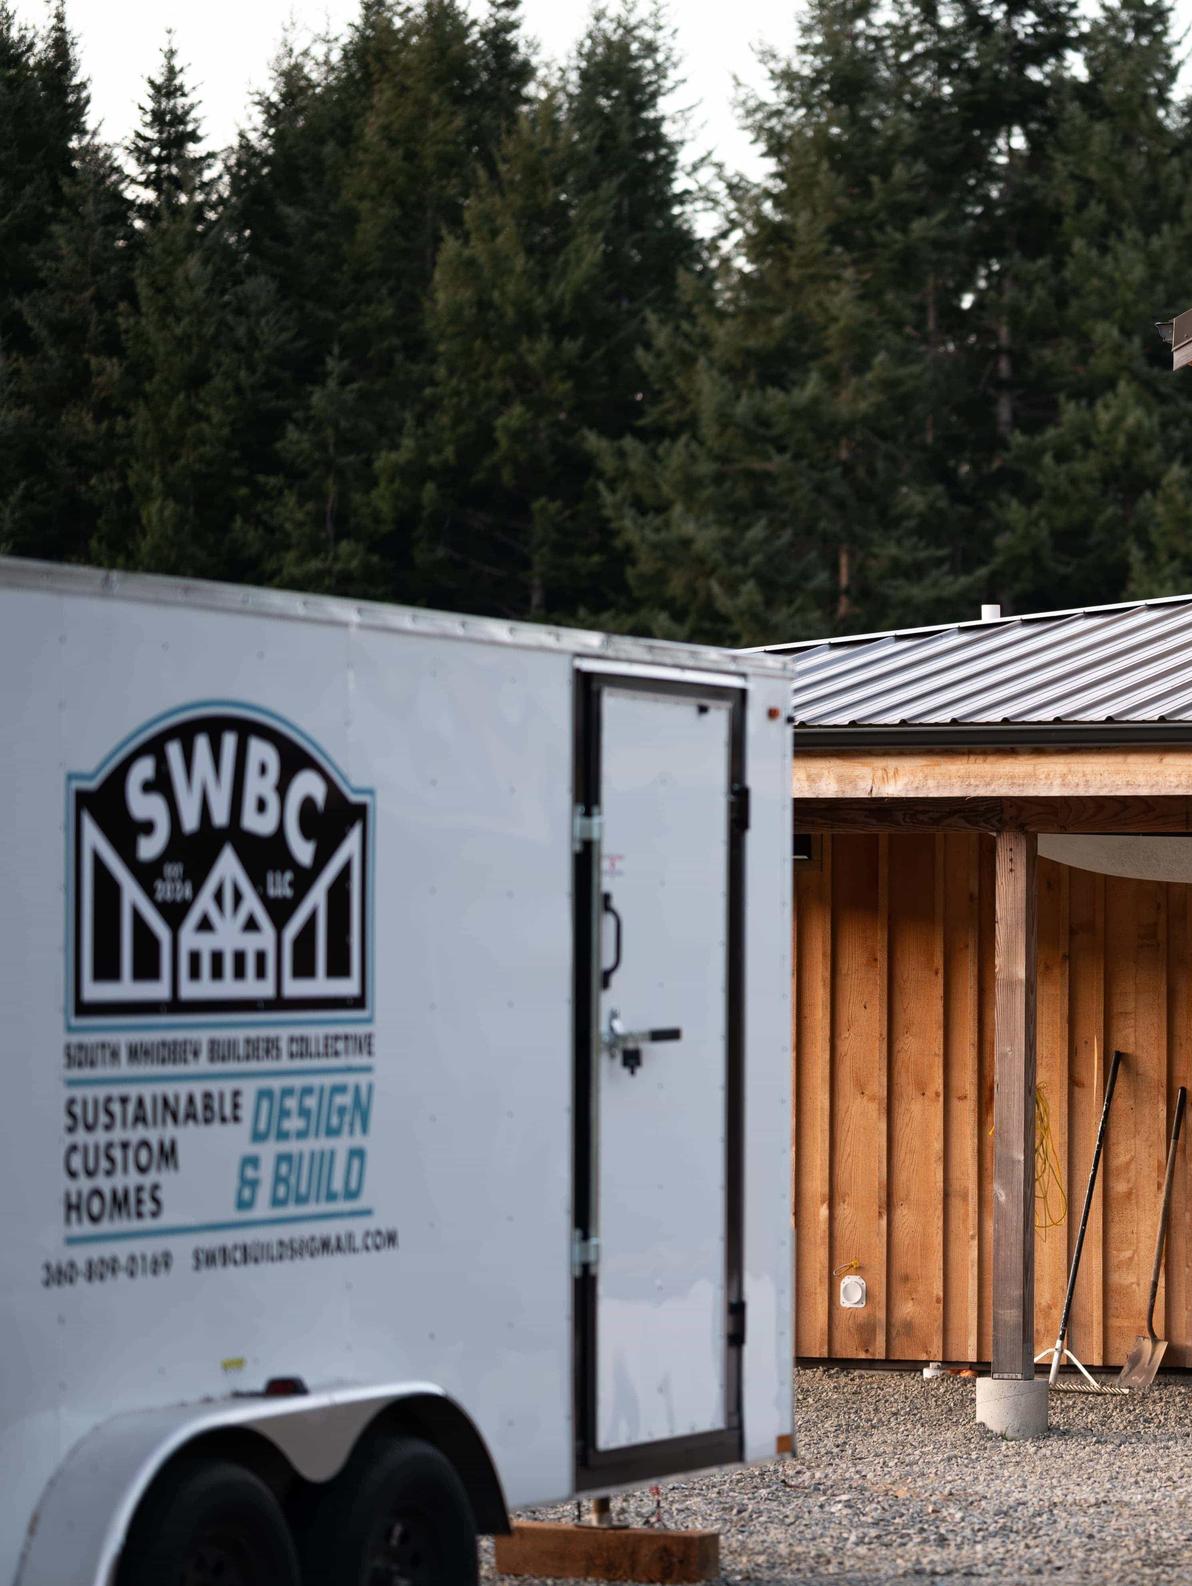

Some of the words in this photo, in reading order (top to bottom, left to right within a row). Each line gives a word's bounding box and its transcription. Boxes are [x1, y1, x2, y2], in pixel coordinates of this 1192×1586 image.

[125, 731, 327, 869] SWBC
[266, 869, 294, 898] LLC
[64, 1041, 121, 1069] SOUTH
[126, 1038, 201, 1067] WHIDBEY
[207, 1035, 282, 1064] BUILDERS
[287, 1032, 374, 1060] COLLECTIVE
[64, 1089, 243, 1134] SUSTAINABLE
[249, 1082, 374, 1144] DESIGN
[64, 1137, 179, 1181] CUSTOM
[235, 1153, 260, 1212] &
[268, 1146, 367, 1209] BUILD
[64, 1183, 162, 1227] HOMES
